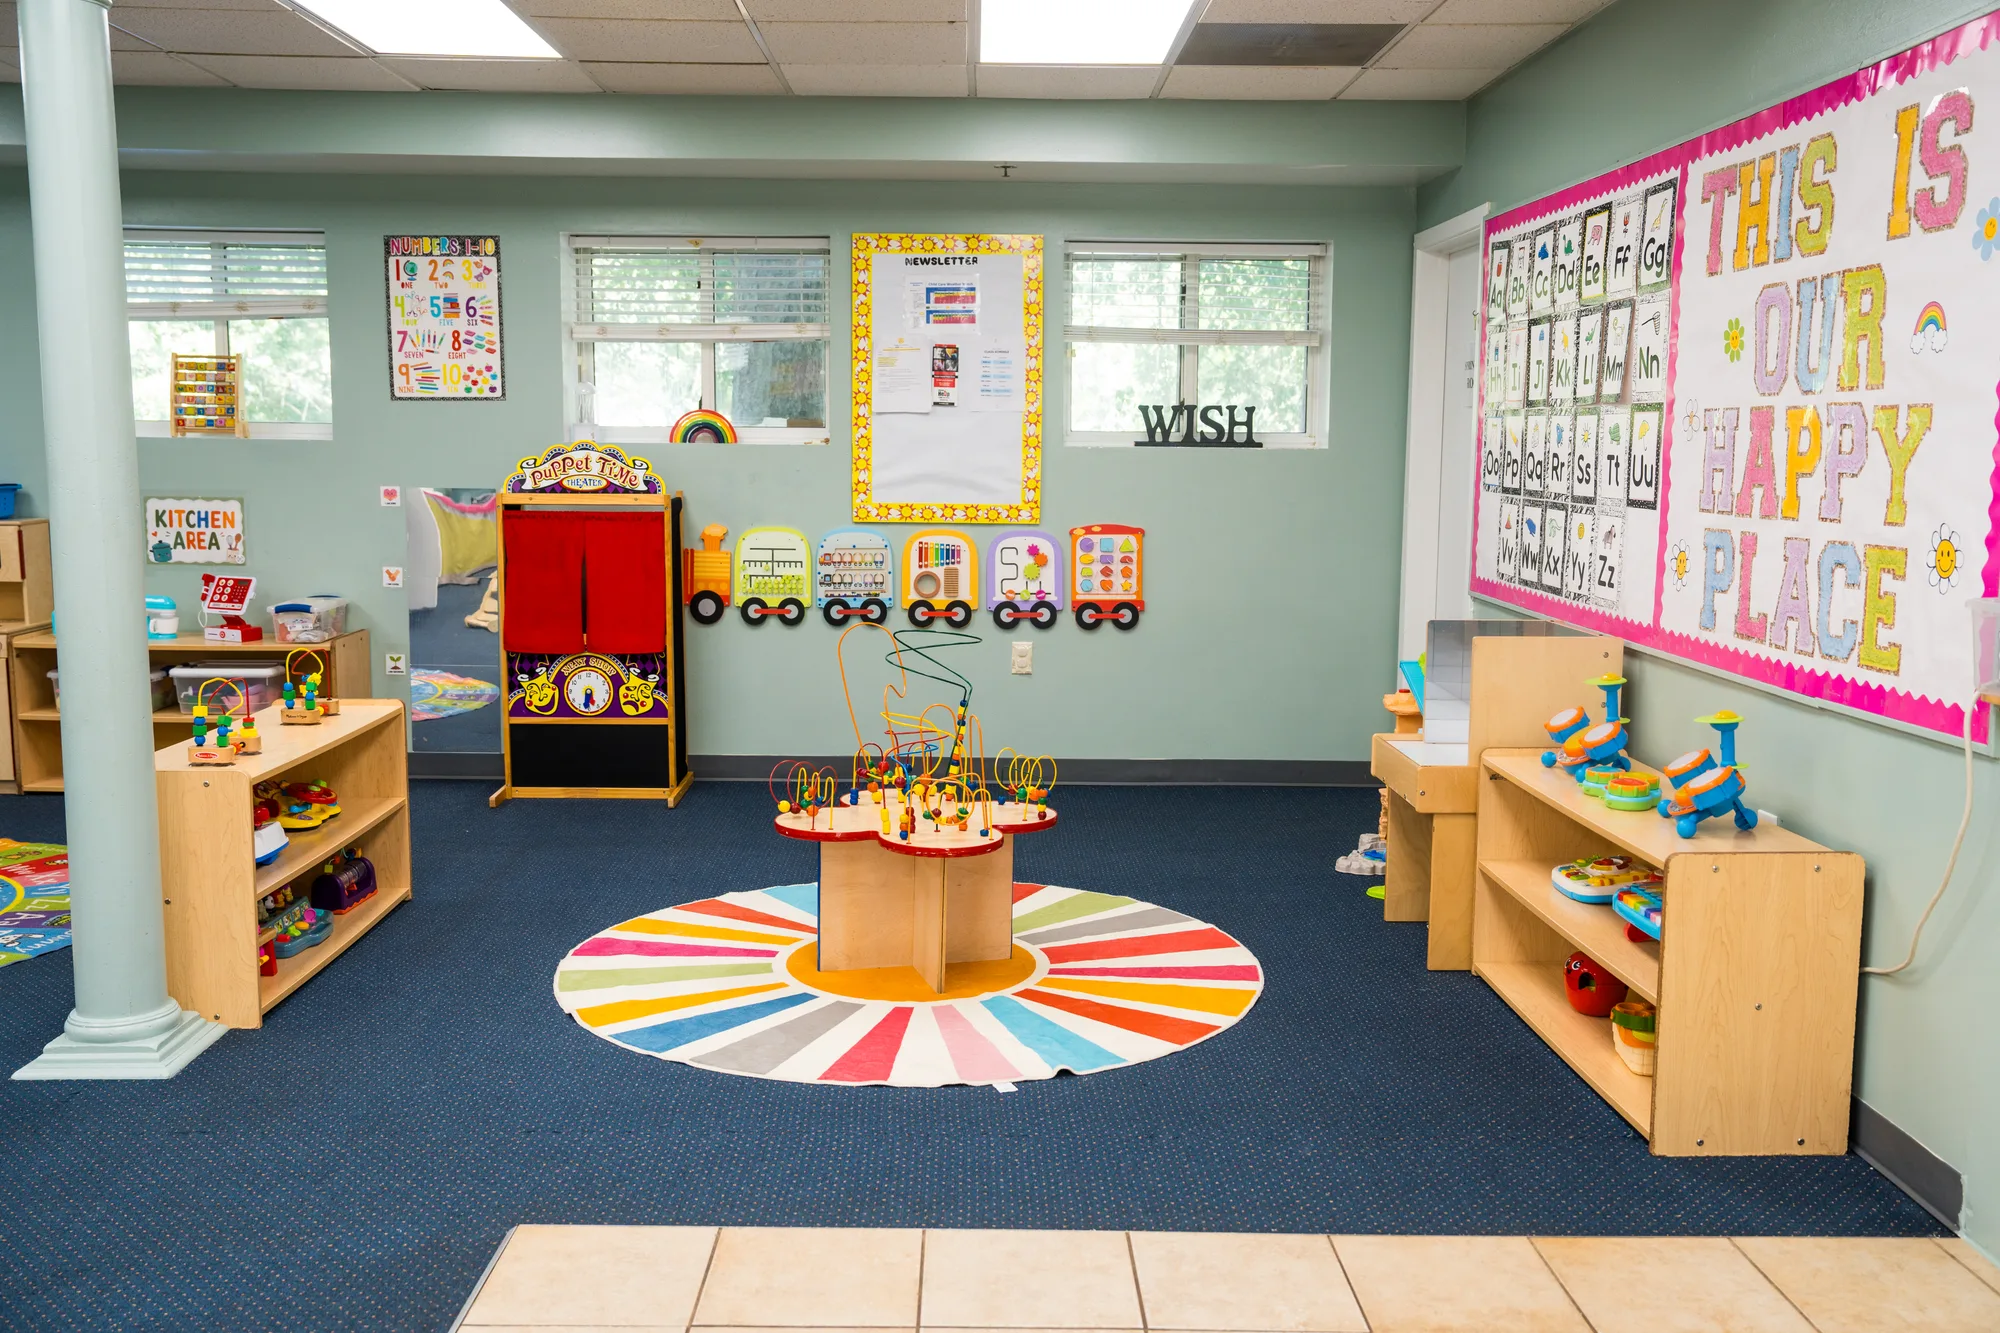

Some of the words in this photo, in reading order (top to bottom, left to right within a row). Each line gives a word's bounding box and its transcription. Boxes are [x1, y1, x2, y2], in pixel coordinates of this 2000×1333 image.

[1701, 131, 1838, 278] THIS
[1886, 86, 1976, 241] IS
[390, 236, 460, 256] NUMBERS
[465, 238, 495, 256] 1-10
[428, 259, 439, 281] 2
[461, 259, 473, 281] 3
[905, 257, 978, 266] NEWSLETTER
[1512, 276, 1525, 305] Bb
[1535, 270, 1548, 298] Cc
[1558, 263, 1575, 293] Dd
[1585, 254, 1601, 286] Ee
[1614, 244, 1631, 279] Ff
[1643, 237, 1665, 278] Gg
[394, 295, 405, 318] 4
[429, 295, 441, 318] 5
[465, 296, 477, 318] 6
[397, 330, 408, 352] 7
[452, 330, 461, 351] 8
[1753, 263, 1887, 397] OUR
[398, 363, 410, 385] 9
[442, 363, 462, 386] 10
[1556, 357, 1571, 388] Kk
[1605, 355, 1623, 383] Mm
[1638, 346, 1660, 380] Nn
[1138, 405, 1256, 443] WISH
[1486, 450, 1500, 476] Oo
[1505, 450, 1519, 485] Pp
[1526, 451, 1543, 488] Qq
[1551, 452, 1565, 483] Rr
[1576, 453, 1591, 485] Ss
[1607, 454, 1620, 487] Tt
[1632, 454, 1654, 488] Uu
[1699, 401, 1933, 527] HAPPY
[567, 478, 602, 488] THEATER
[155, 509, 236, 529] KITCHEN
[173, 531, 221, 550] AREA
[1501, 537, 1514, 565] Vv
[1521, 542, 1538, 572] Ww
[1544, 545, 1560, 577] Xx
[1571, 551, 1586, 590] Yy
[1597, 554, 1615, 589] Zz
[1699, 527, 1908, 676] PLACE
[561, 657, 587, 676] NEXT
[589, 657, 617, 676] SHOW
